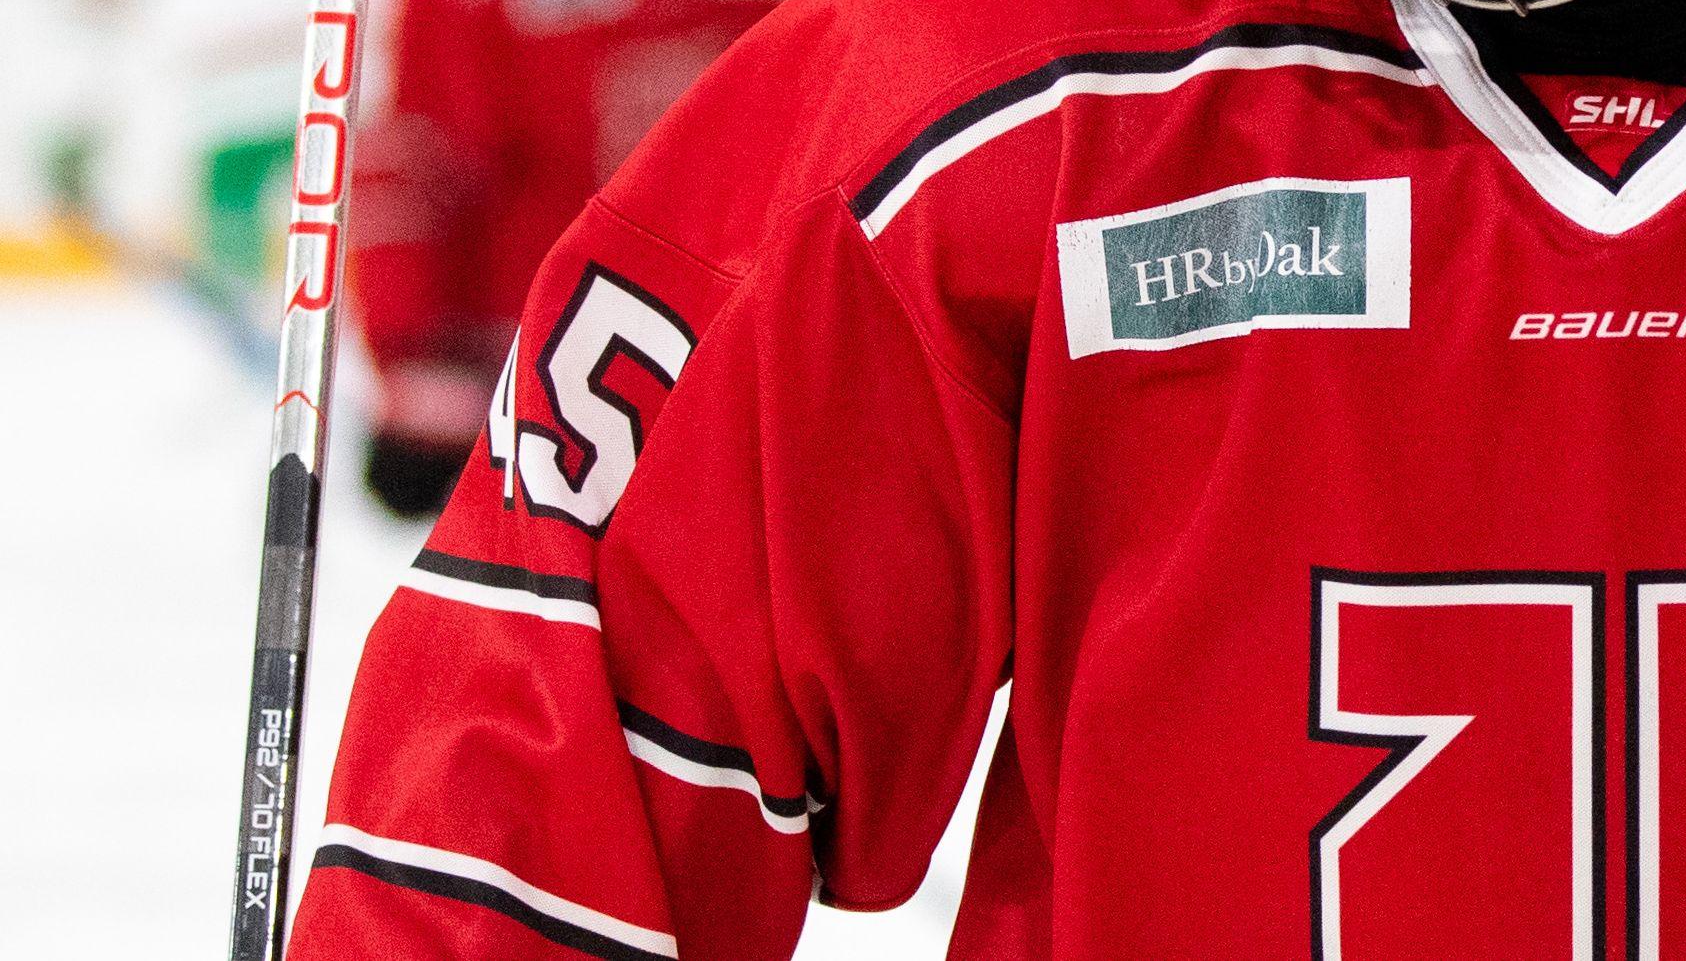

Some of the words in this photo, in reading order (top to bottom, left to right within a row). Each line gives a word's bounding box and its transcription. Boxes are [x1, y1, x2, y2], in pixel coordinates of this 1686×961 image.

[1569, 95, 1666, 128] SHL
[255, 709, 283, 767] P92
[244, 836, 272, 910] FLEX
